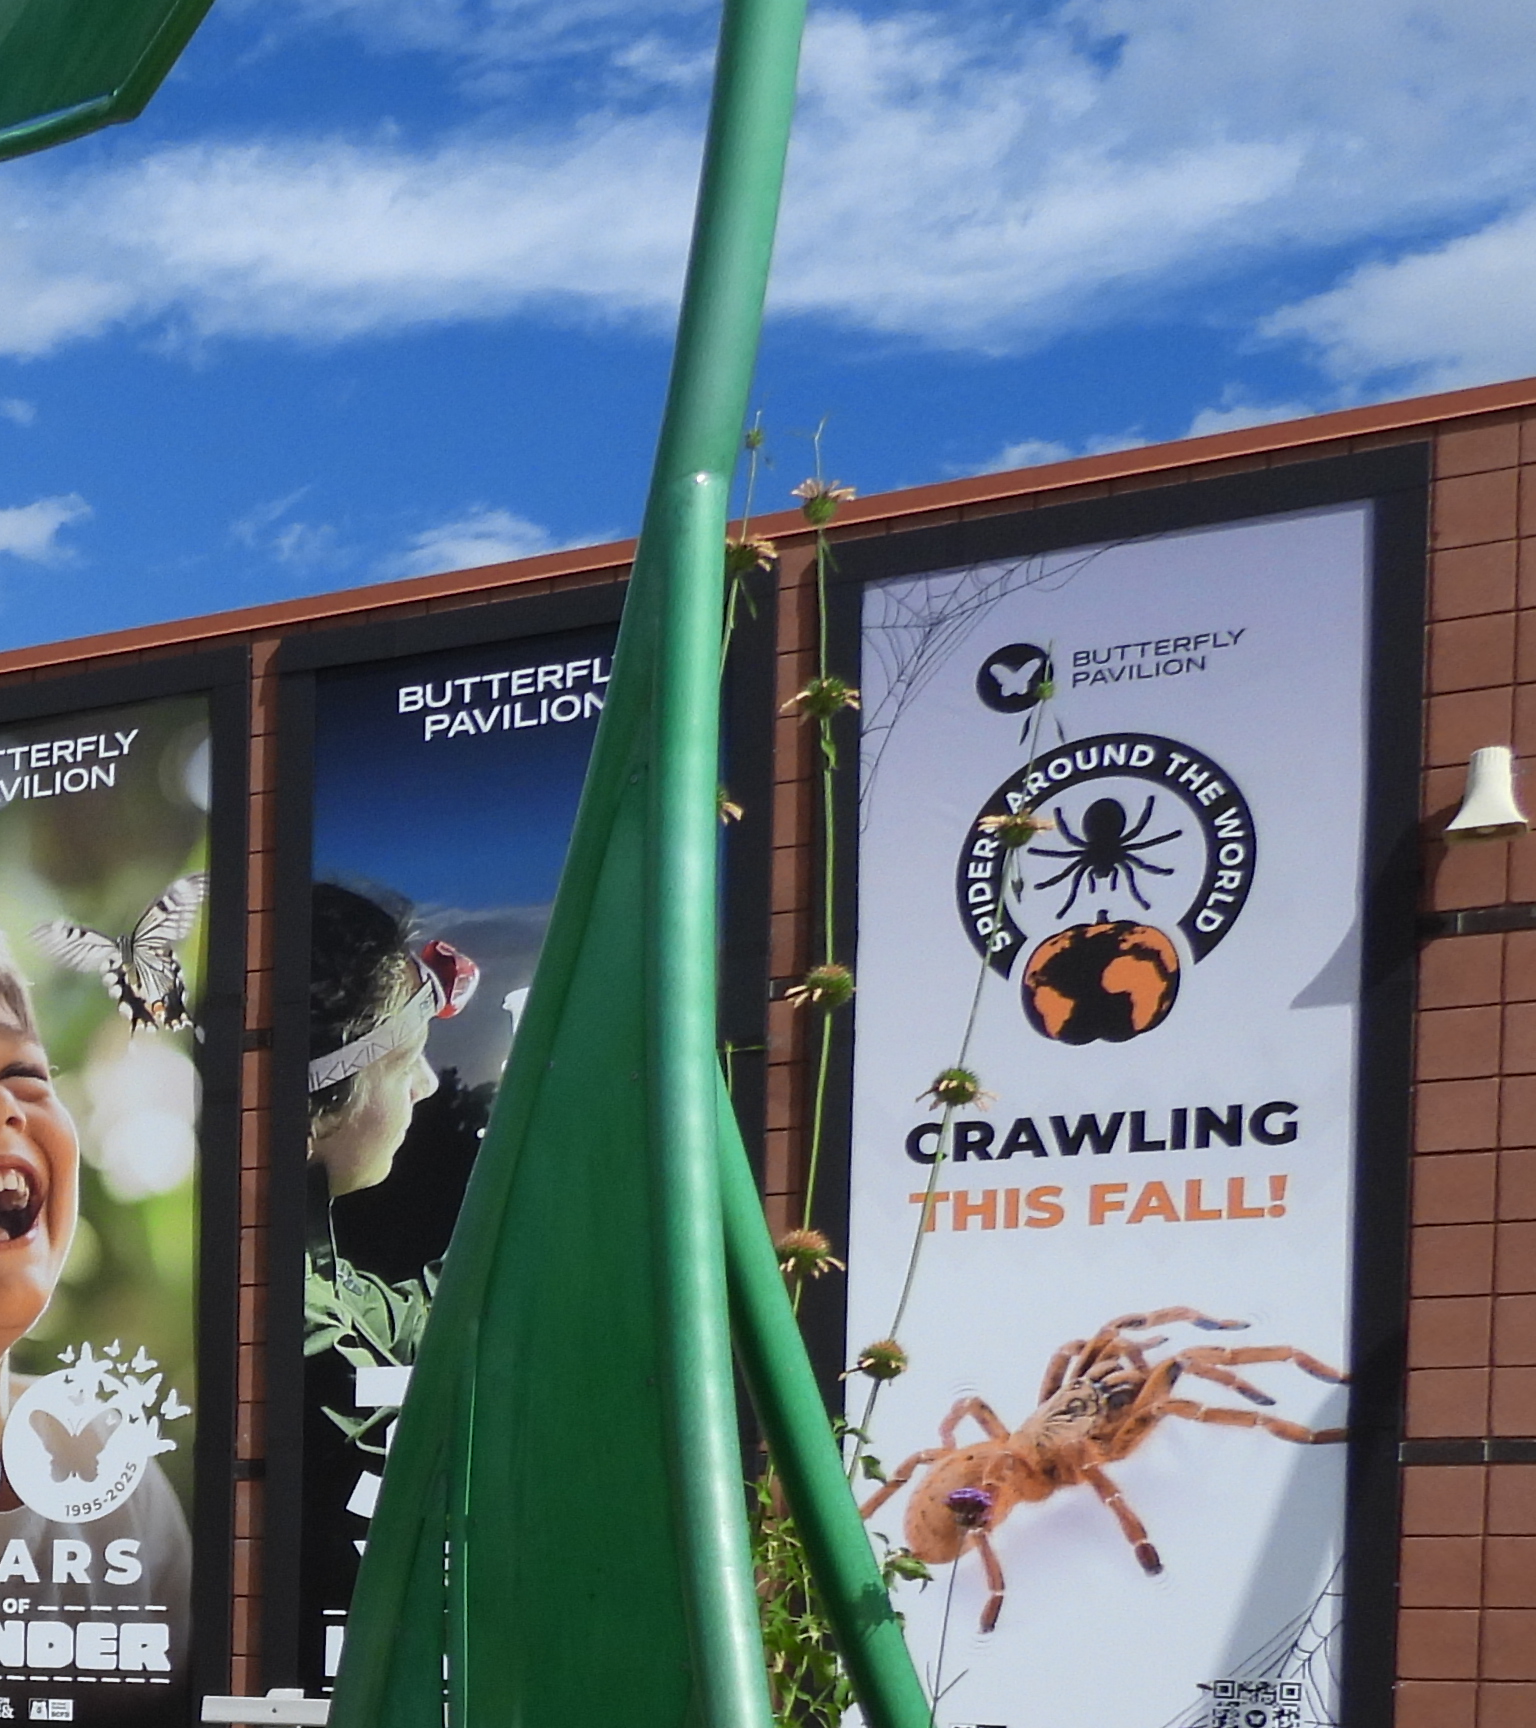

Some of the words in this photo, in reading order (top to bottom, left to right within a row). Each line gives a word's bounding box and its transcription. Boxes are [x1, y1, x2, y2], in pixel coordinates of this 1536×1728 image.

[1072, 656, 1206, 688] PAVILION
[1073, 628, 1246, 668] BUTTERFLY
[398, 655, 615, 713] BUTTERFL
[968, 824, 1012, 952] SPIDER
[1005, 743, 1155, 815] AROUND
[1165, 752, 1226, 807] THE
[1196, 806, 1246, 933] WORLD
[905, 1101, 1299, 1165] CRAWLING
[908, 1185, 1065, 1233] THIS
[1088, 1175, 1289, 1226] FALL!
[65, 1462, 137, 1517] 1995-2025
[2, 1599, 31, 1614] OF
